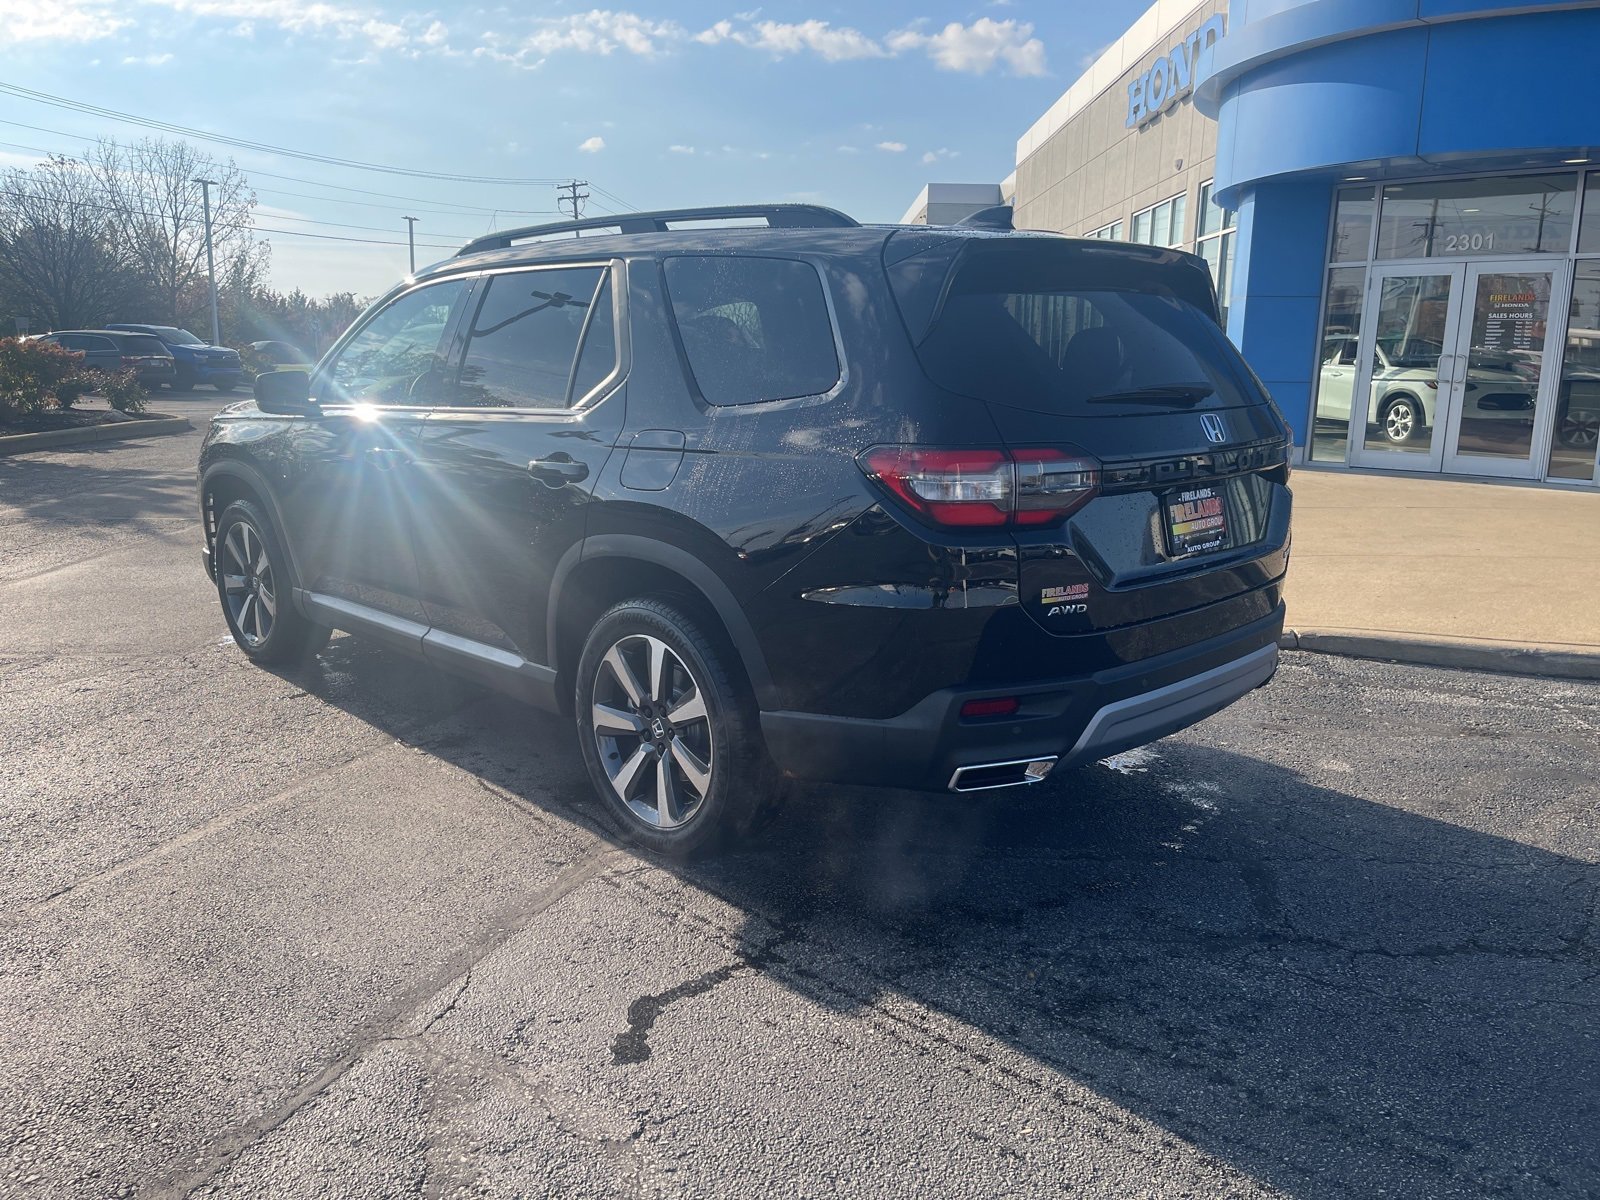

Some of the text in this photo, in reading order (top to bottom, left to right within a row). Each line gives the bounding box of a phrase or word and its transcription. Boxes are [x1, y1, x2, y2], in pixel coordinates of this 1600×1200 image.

[1445, 232, 1495, 252] 2301
[1181, 487, 1212, 502] FIRELANDS
[1170, 496, 1223, 523] FIRELANDS
[1191, 519, 1206, 530] AUTO
[1187, 540, 1220, 553] AUTO GROUP
[1041, 583, 1089, 598] FIRELANDS
[1047, 604, 1088, 617] AWD
